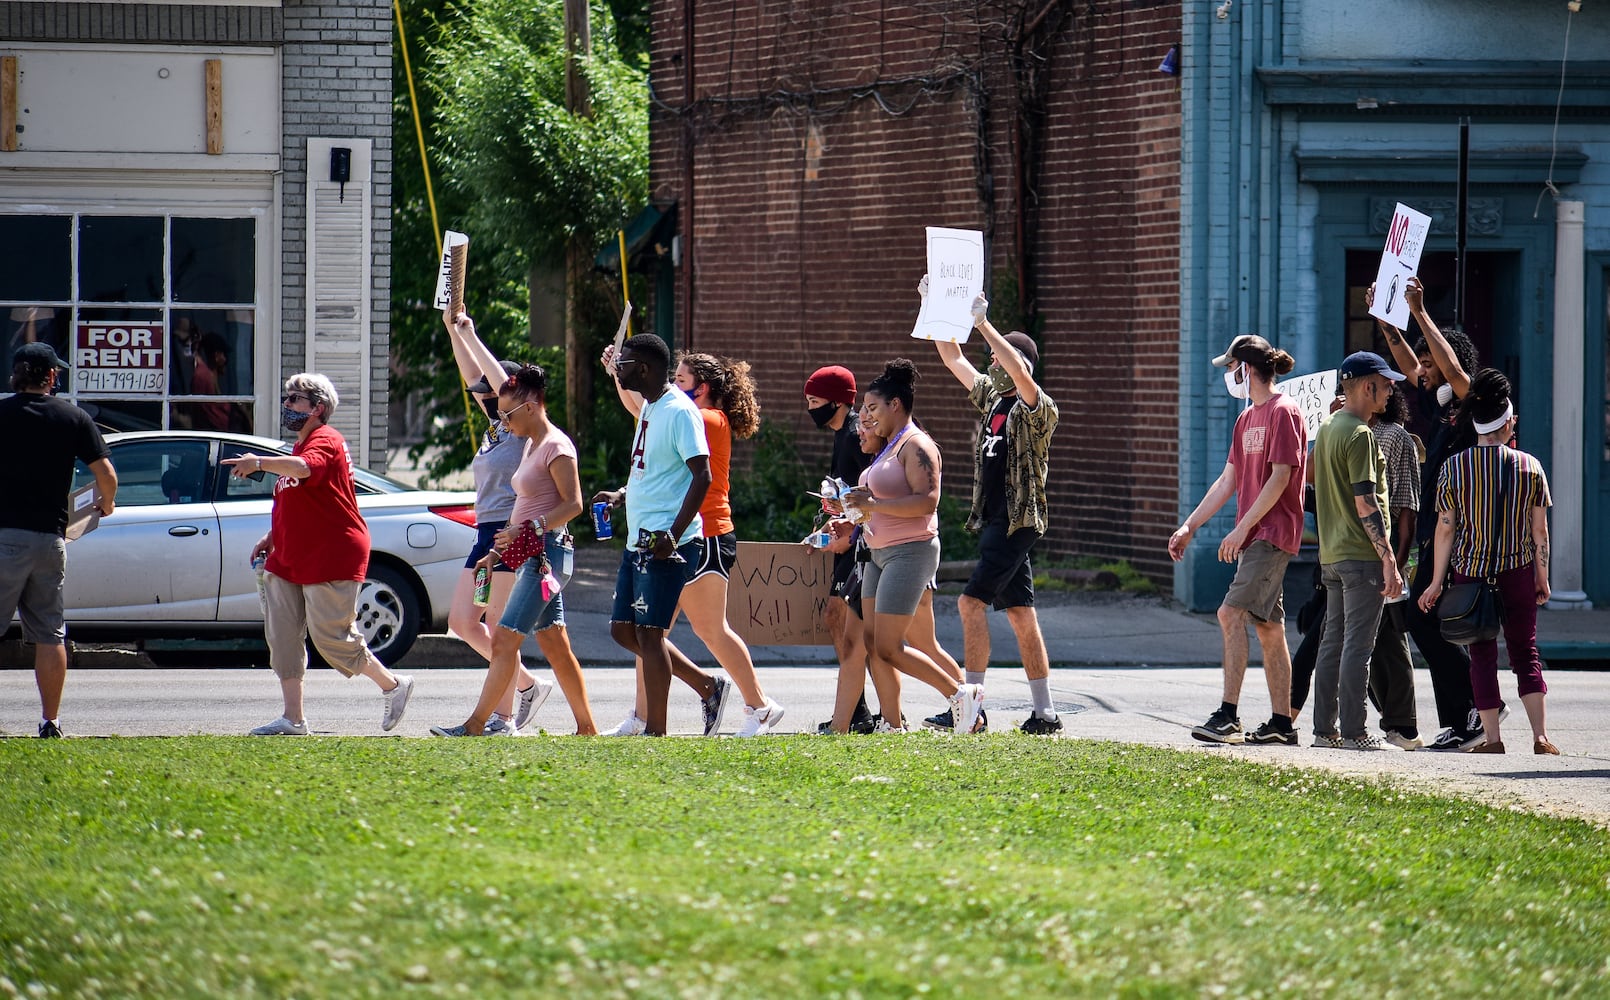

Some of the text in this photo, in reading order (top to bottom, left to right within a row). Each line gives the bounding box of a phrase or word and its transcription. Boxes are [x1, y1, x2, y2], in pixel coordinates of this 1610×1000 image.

[1386, 212, 1409, 256] NO
[940, 261, 974, 281] BLACK LIVES
[944, 286, 969, 299] MATTER
[88, 328, 152, 347] FOR
[77, 348, 163, 367] RENT
[78, 370, 163, 390] 941-799-1130
[735, 553, 834, 588] Woul
[748, 594, 790, 628] Kill
